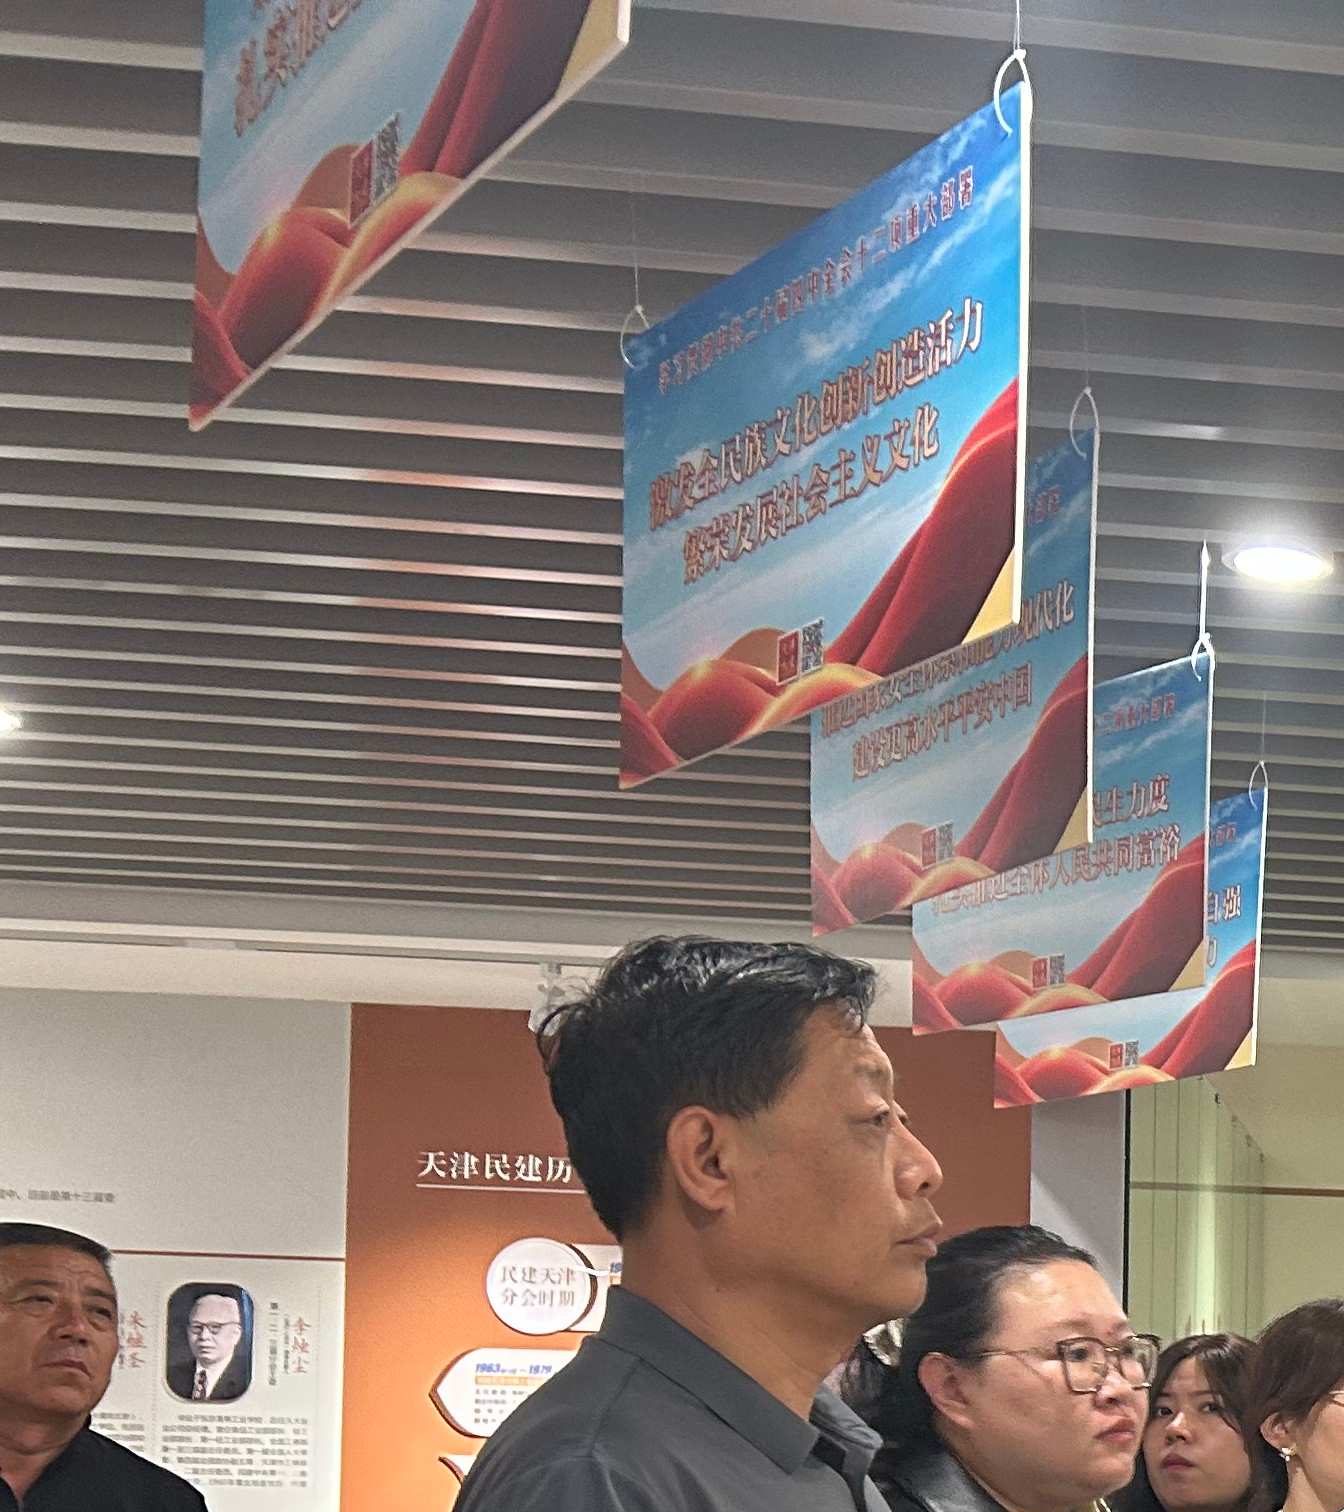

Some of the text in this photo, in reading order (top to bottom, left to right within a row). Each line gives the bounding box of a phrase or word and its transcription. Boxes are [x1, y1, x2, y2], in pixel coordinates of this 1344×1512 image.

[649, 297, 984, 531] 激发全民族文化创新创造活力
[683, 401, 940, 584] 繁荣发展社会主义文化
[417, 1150, 572, 1183] 天津民建历
[500, 1265, 577, 1286] 民建天津
[500, 1288, 576, 1308] 分会时期
